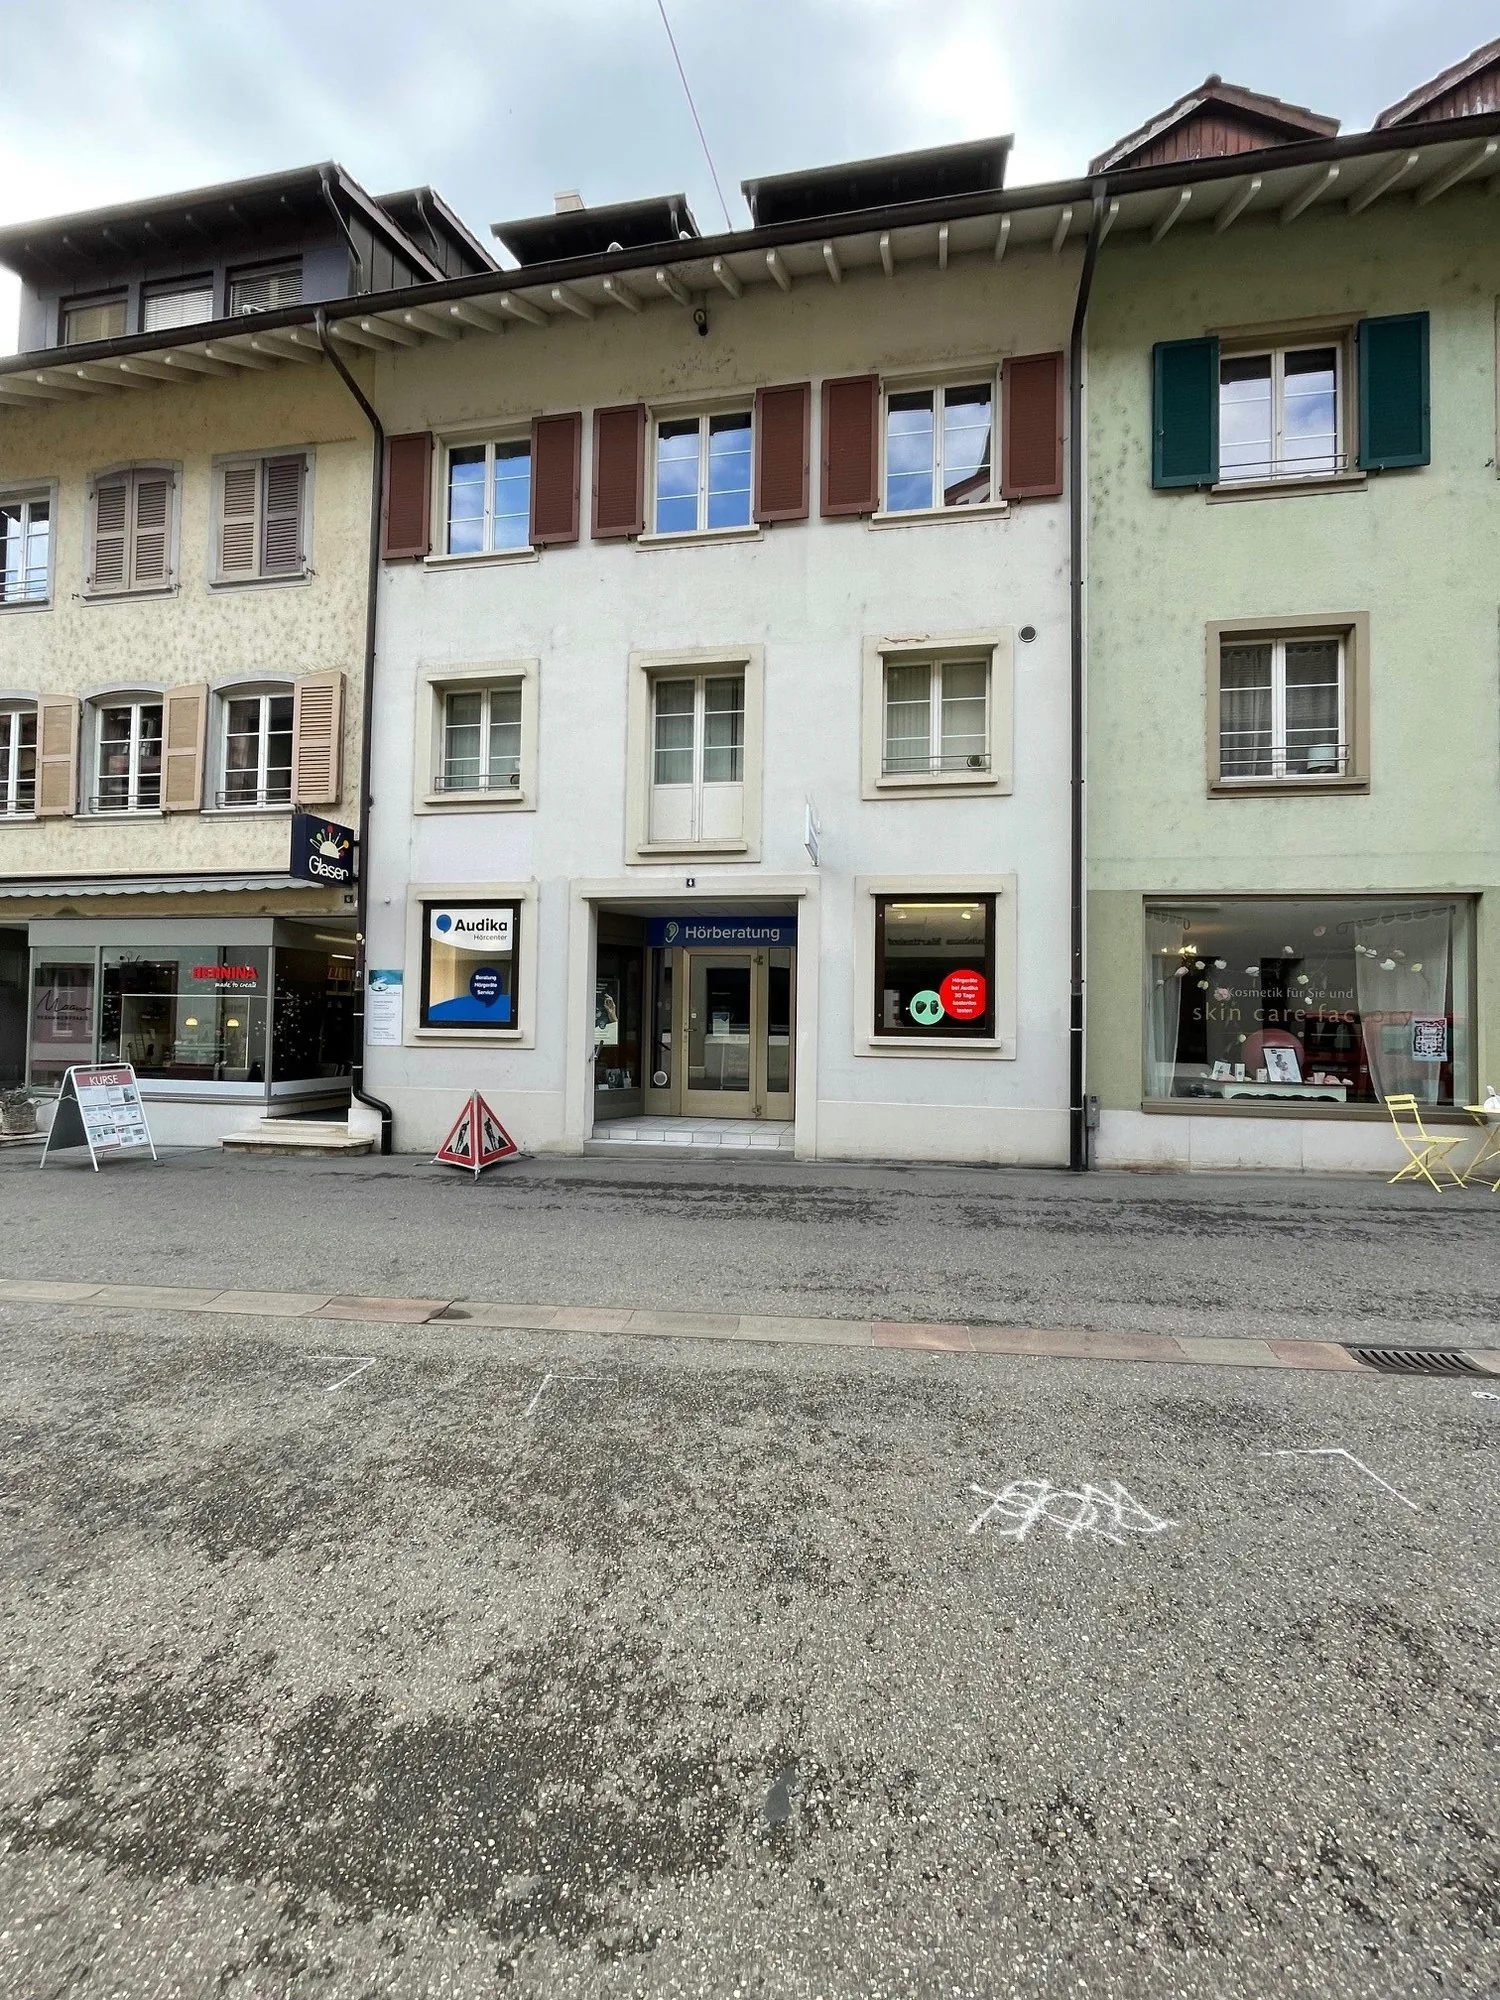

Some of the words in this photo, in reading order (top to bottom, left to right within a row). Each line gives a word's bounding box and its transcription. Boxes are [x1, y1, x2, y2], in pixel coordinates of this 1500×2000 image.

[309, 855, 349, 880] Glaser
[454, 918, 508, 932] Audika
[473, 933, 507, 941] Hörcenter
[685, 926, 780, 942] Hörberatung
[192, 966, 258, 980] BERNINA
[1286, 988, 1303, 998] für
[1308, 988, 1326, 998] Sie
[1329, 989, 1353, 998] und
[1192, 1002, 1241, 1021] skin
[1253, 1008, 1306, 1022] care
[89, 1074, 119, 1086] KURSE
